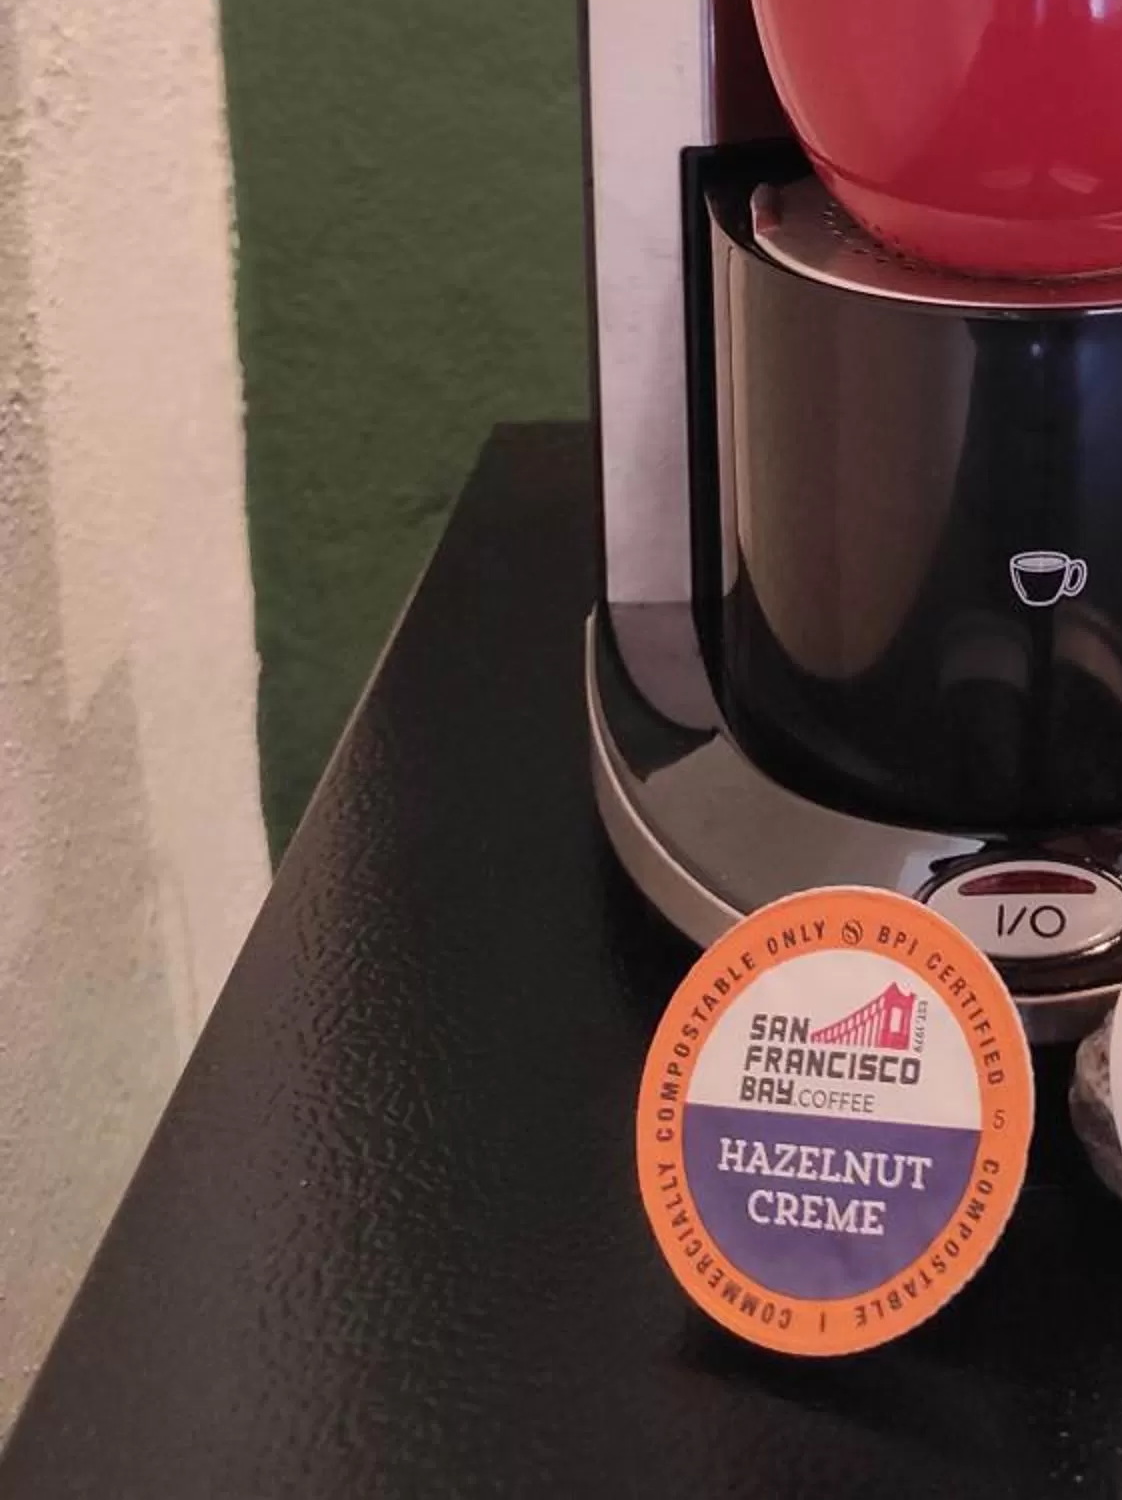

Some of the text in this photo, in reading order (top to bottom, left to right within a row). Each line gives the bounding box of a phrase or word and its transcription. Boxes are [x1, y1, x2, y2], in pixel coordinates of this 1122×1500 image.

[750, 1013, 811, 1044] SAN
[877, 925, 1005, 1086] BPI CERTIFIED
[744, 1046, 922, 1085] FRANCISCO
[656, 920, 826, 1331] COMMERCIALLY COMPOSTABLE ONLY
[717, 1137, 933, 1190] HAZELNUT
[747, 1189, 887, 1236] CREME
[854, 1158, 1001, 1328] COMPOSTABLE
